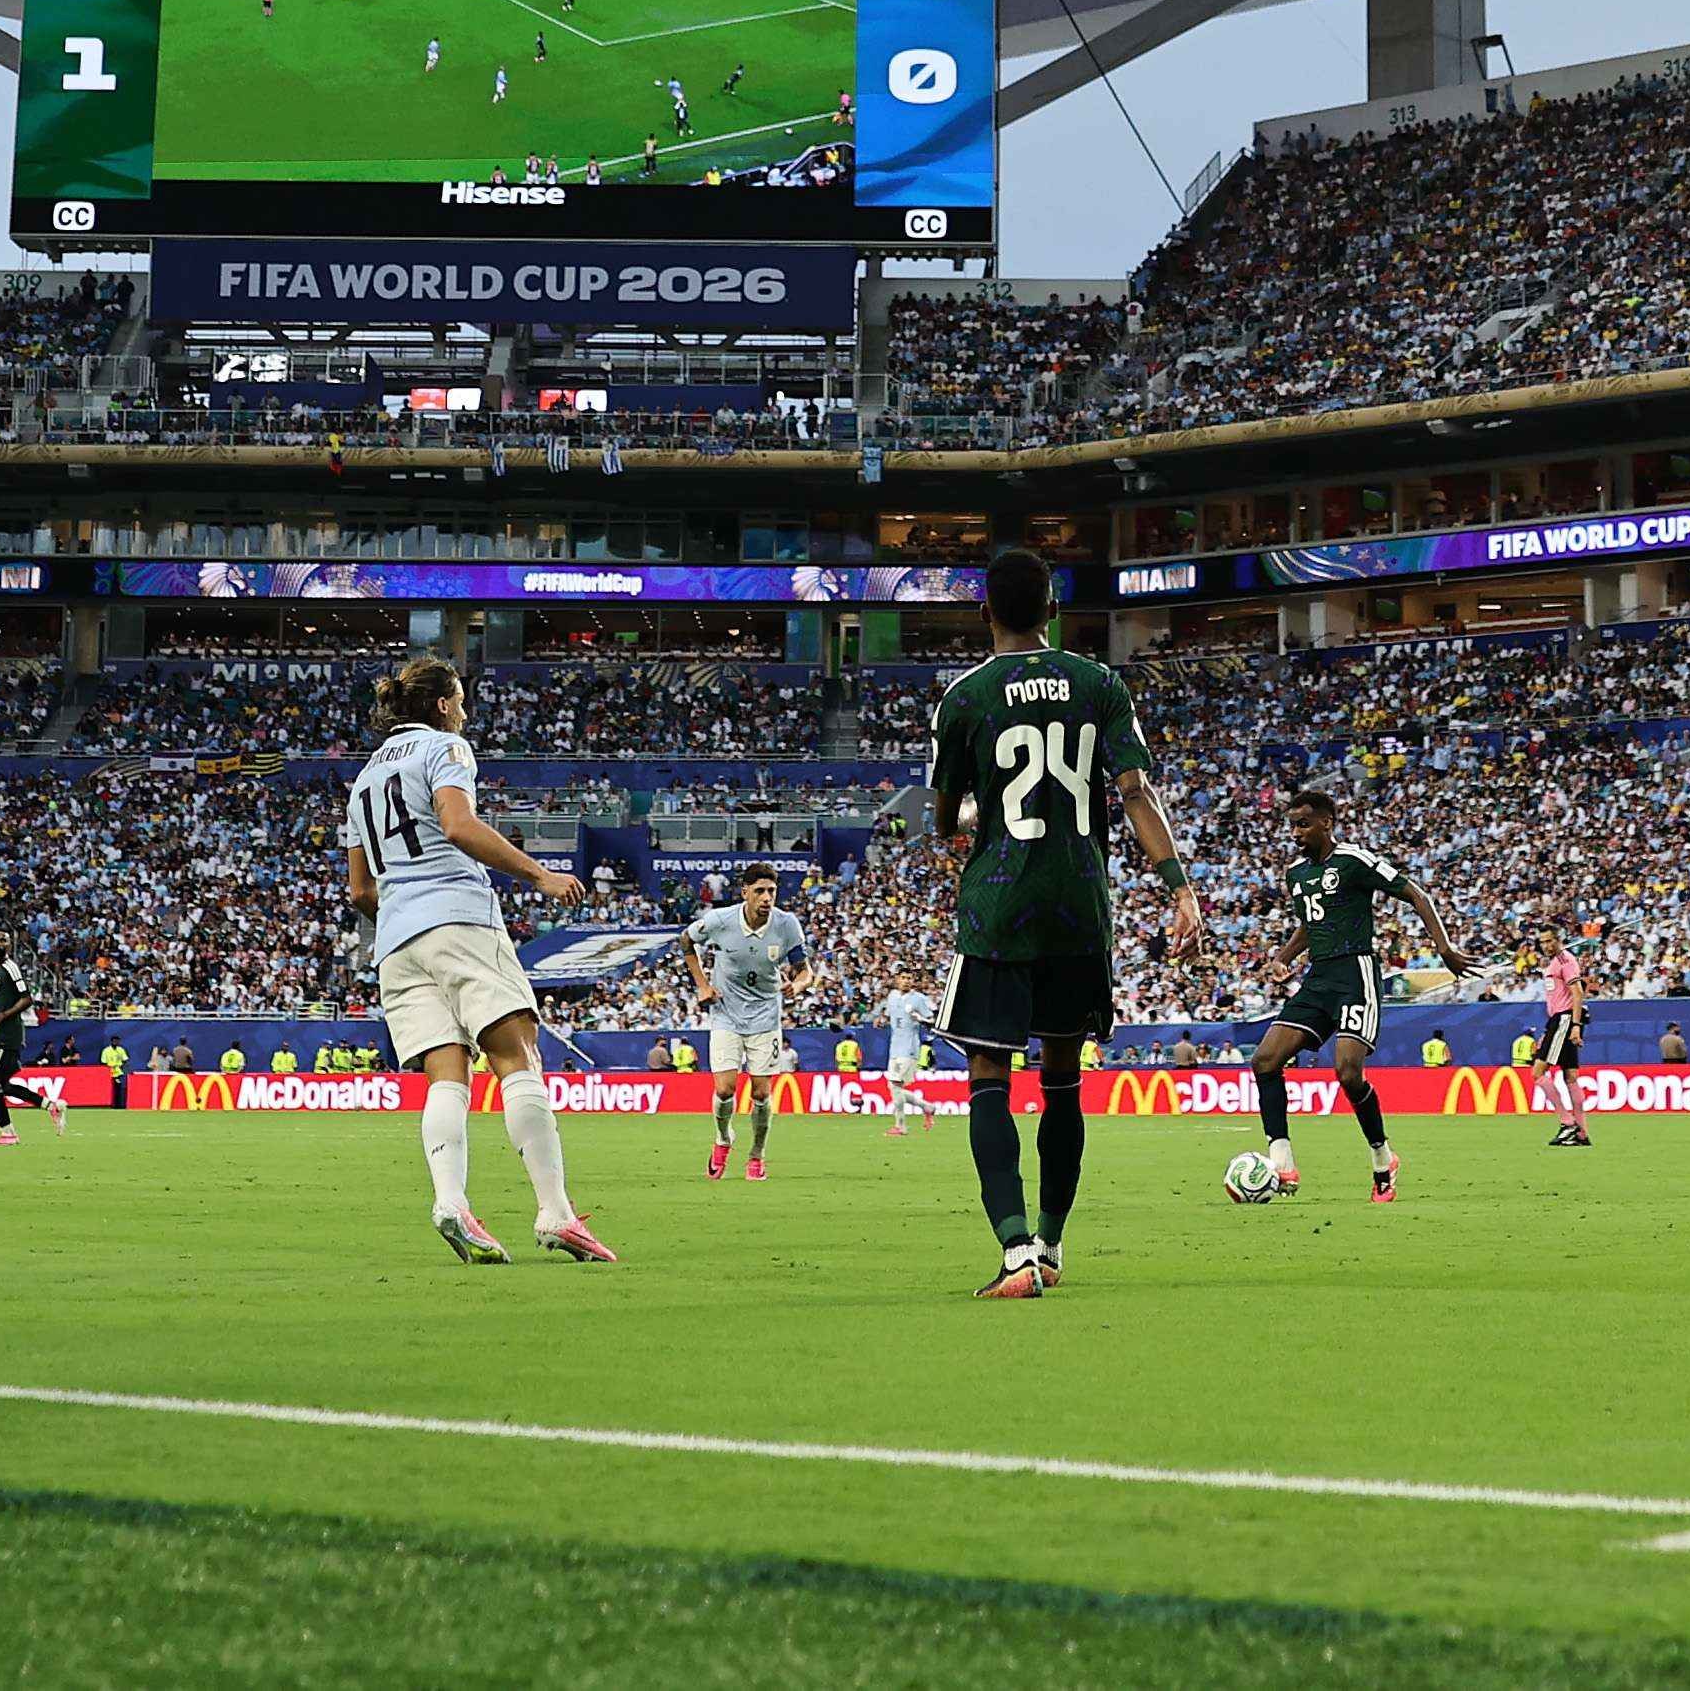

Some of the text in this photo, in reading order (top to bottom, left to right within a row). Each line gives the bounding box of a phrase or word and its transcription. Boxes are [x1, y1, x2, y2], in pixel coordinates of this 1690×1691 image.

[62, 36, 117, 91] 1
[888, 48, 957, 104] 0
[1389, 105, 1416, 126] 313
[441, 181, 566, 206] Hisense
[58, 207, 90, 226] CC
[910, 215, 942, 233] CC
[5, 273, 43, 293] 309
[220, 262, 786, 304] FIFA WORLD CUP 2026
[976, 281, 1013, 300] 312
[1488, 530, 1543, 560] FIFA
[1544, 521, 1638, 554] WORLD
[523, 572, 643, 596] #FIFAWorldCup
[1119, 565, 1196, 595] MIAMI
[1005, 678, 1070, 707] MOTEB
[996, 721, 1096, 840] 24
[359, 772, 424, 876] 14
[536, 859, 574, 871] 026
[652, 860, 683, 871] FIFA
[1303, 892, 1325, 922] 15
[746, 971, 757, 987] 8
[1340, 1004, 1365, 1030] 15
[772, 1038, 780, 1059] 8
[237, 1076, 400, 1111] McDonald's
[545, 1073, 663, 1114] Delivery
